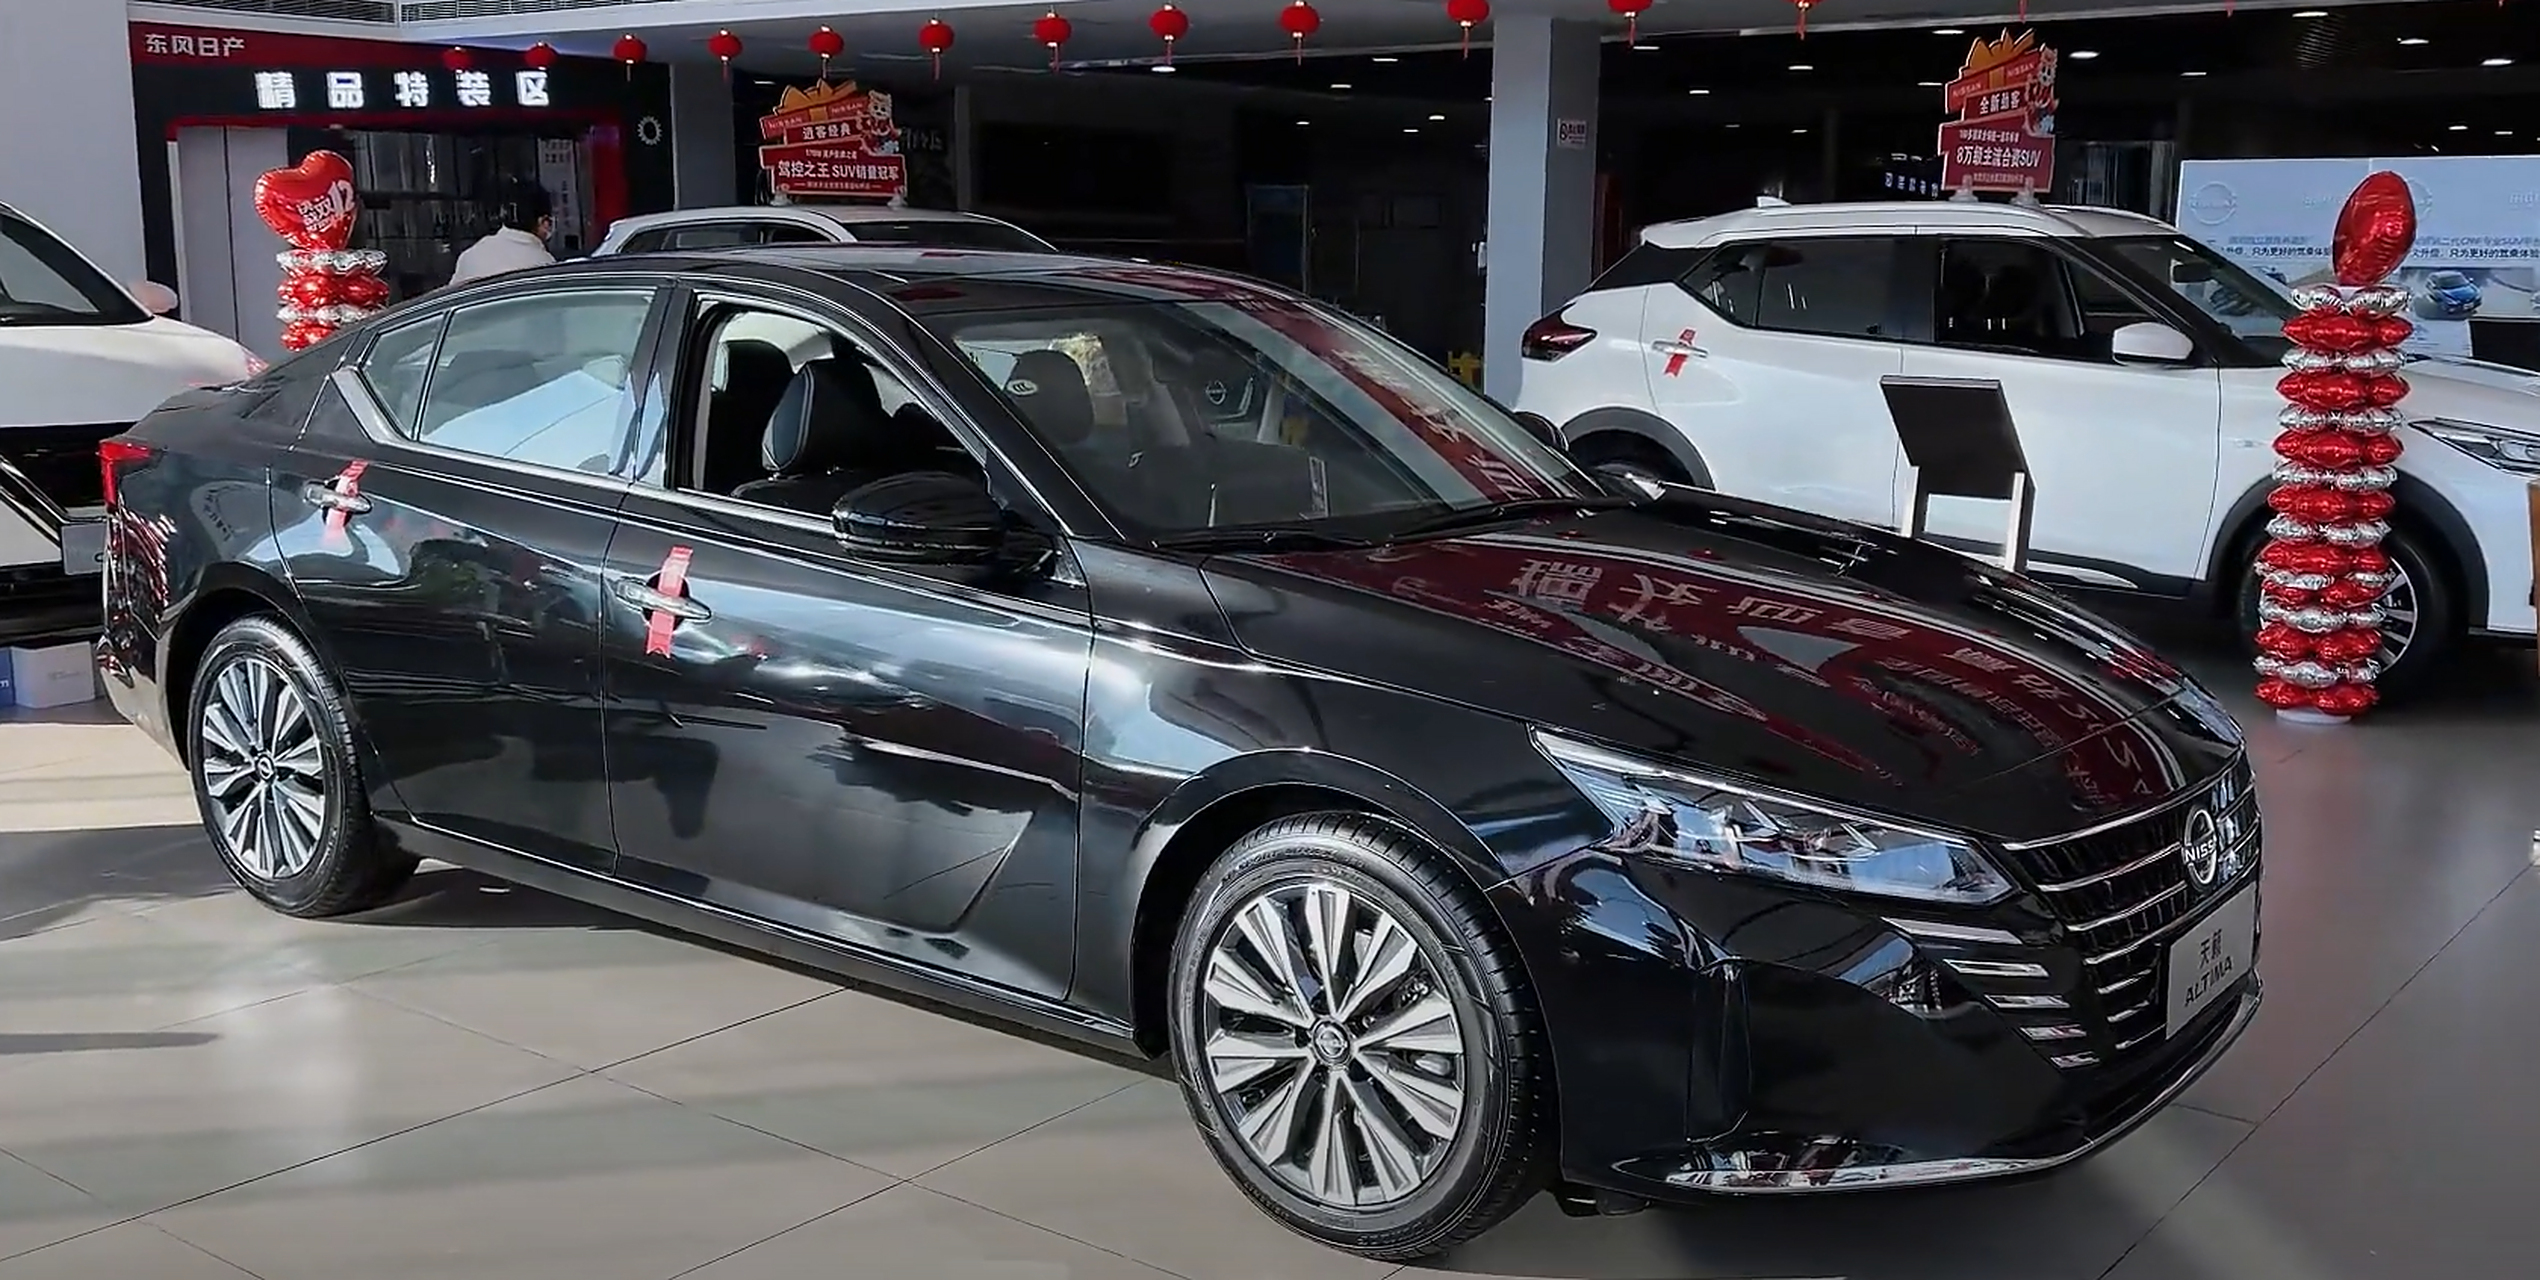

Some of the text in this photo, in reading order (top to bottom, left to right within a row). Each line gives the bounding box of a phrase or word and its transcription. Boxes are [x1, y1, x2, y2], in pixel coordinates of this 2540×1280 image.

[144, 33, 246, 57] 东风日产
[254, 70, 550, 109] 精品特装区
[2184, 838, 2217, 863] NISS
[2184, 955, 2233, 1007] ALTIMA
